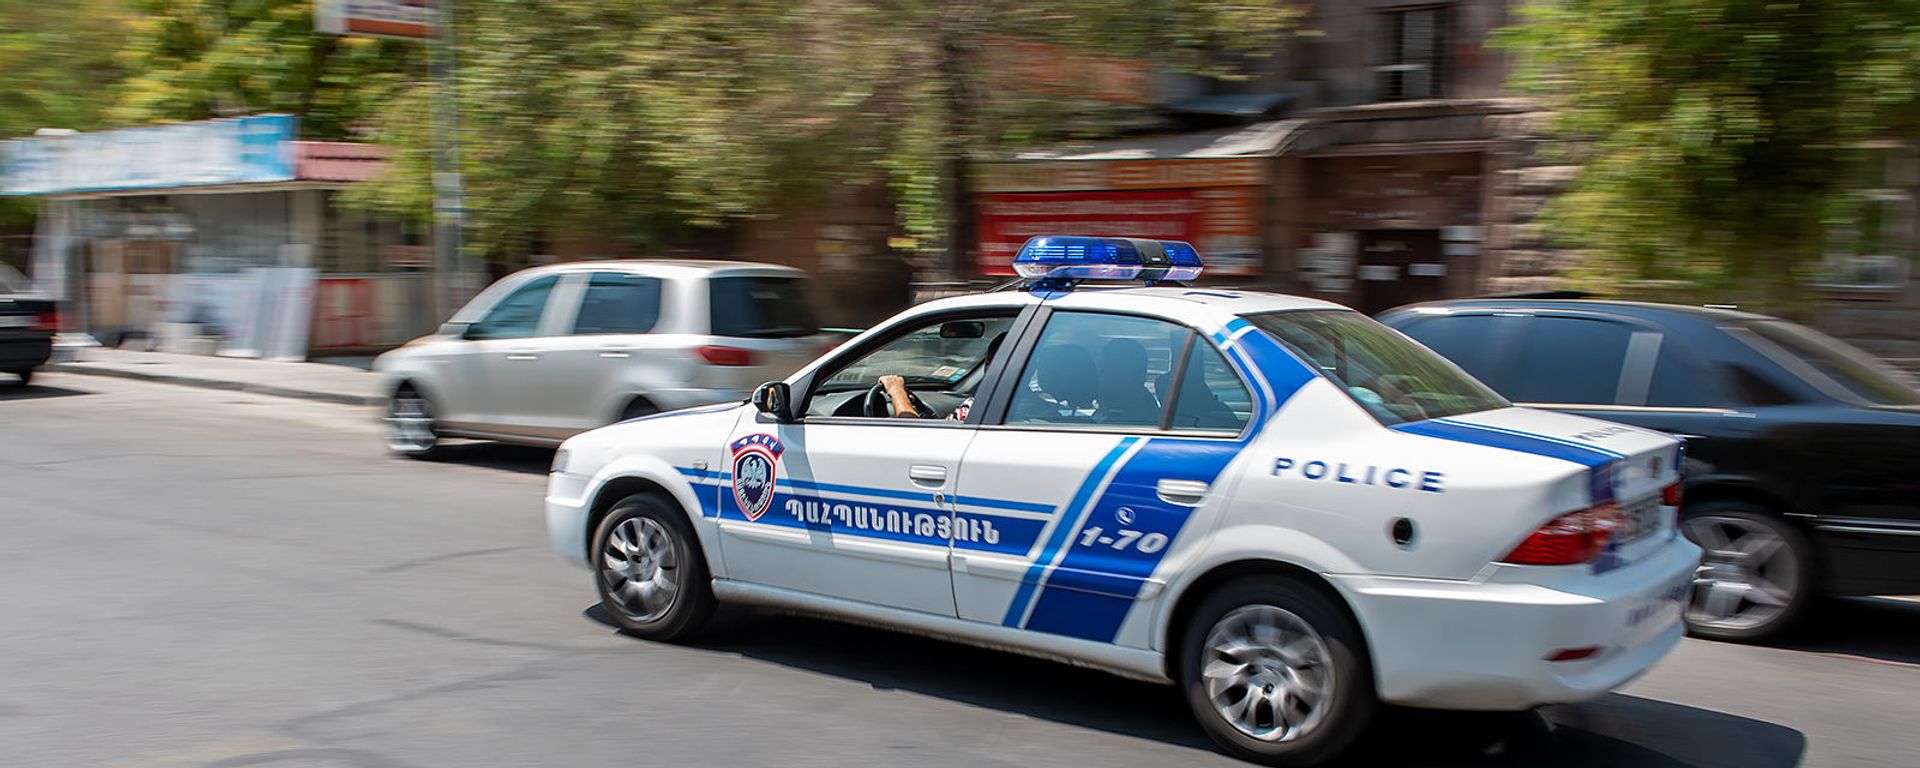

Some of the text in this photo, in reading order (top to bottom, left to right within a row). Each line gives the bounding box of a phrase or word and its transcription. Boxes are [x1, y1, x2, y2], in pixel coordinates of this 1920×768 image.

[1272, 457, 1446, 493] POLICE
[785, 498, 1000, 545] ՊԱՀՊԱՆՈՒԹՅՈՒՆ
[1079, 525, 1169, 554] 1-70
